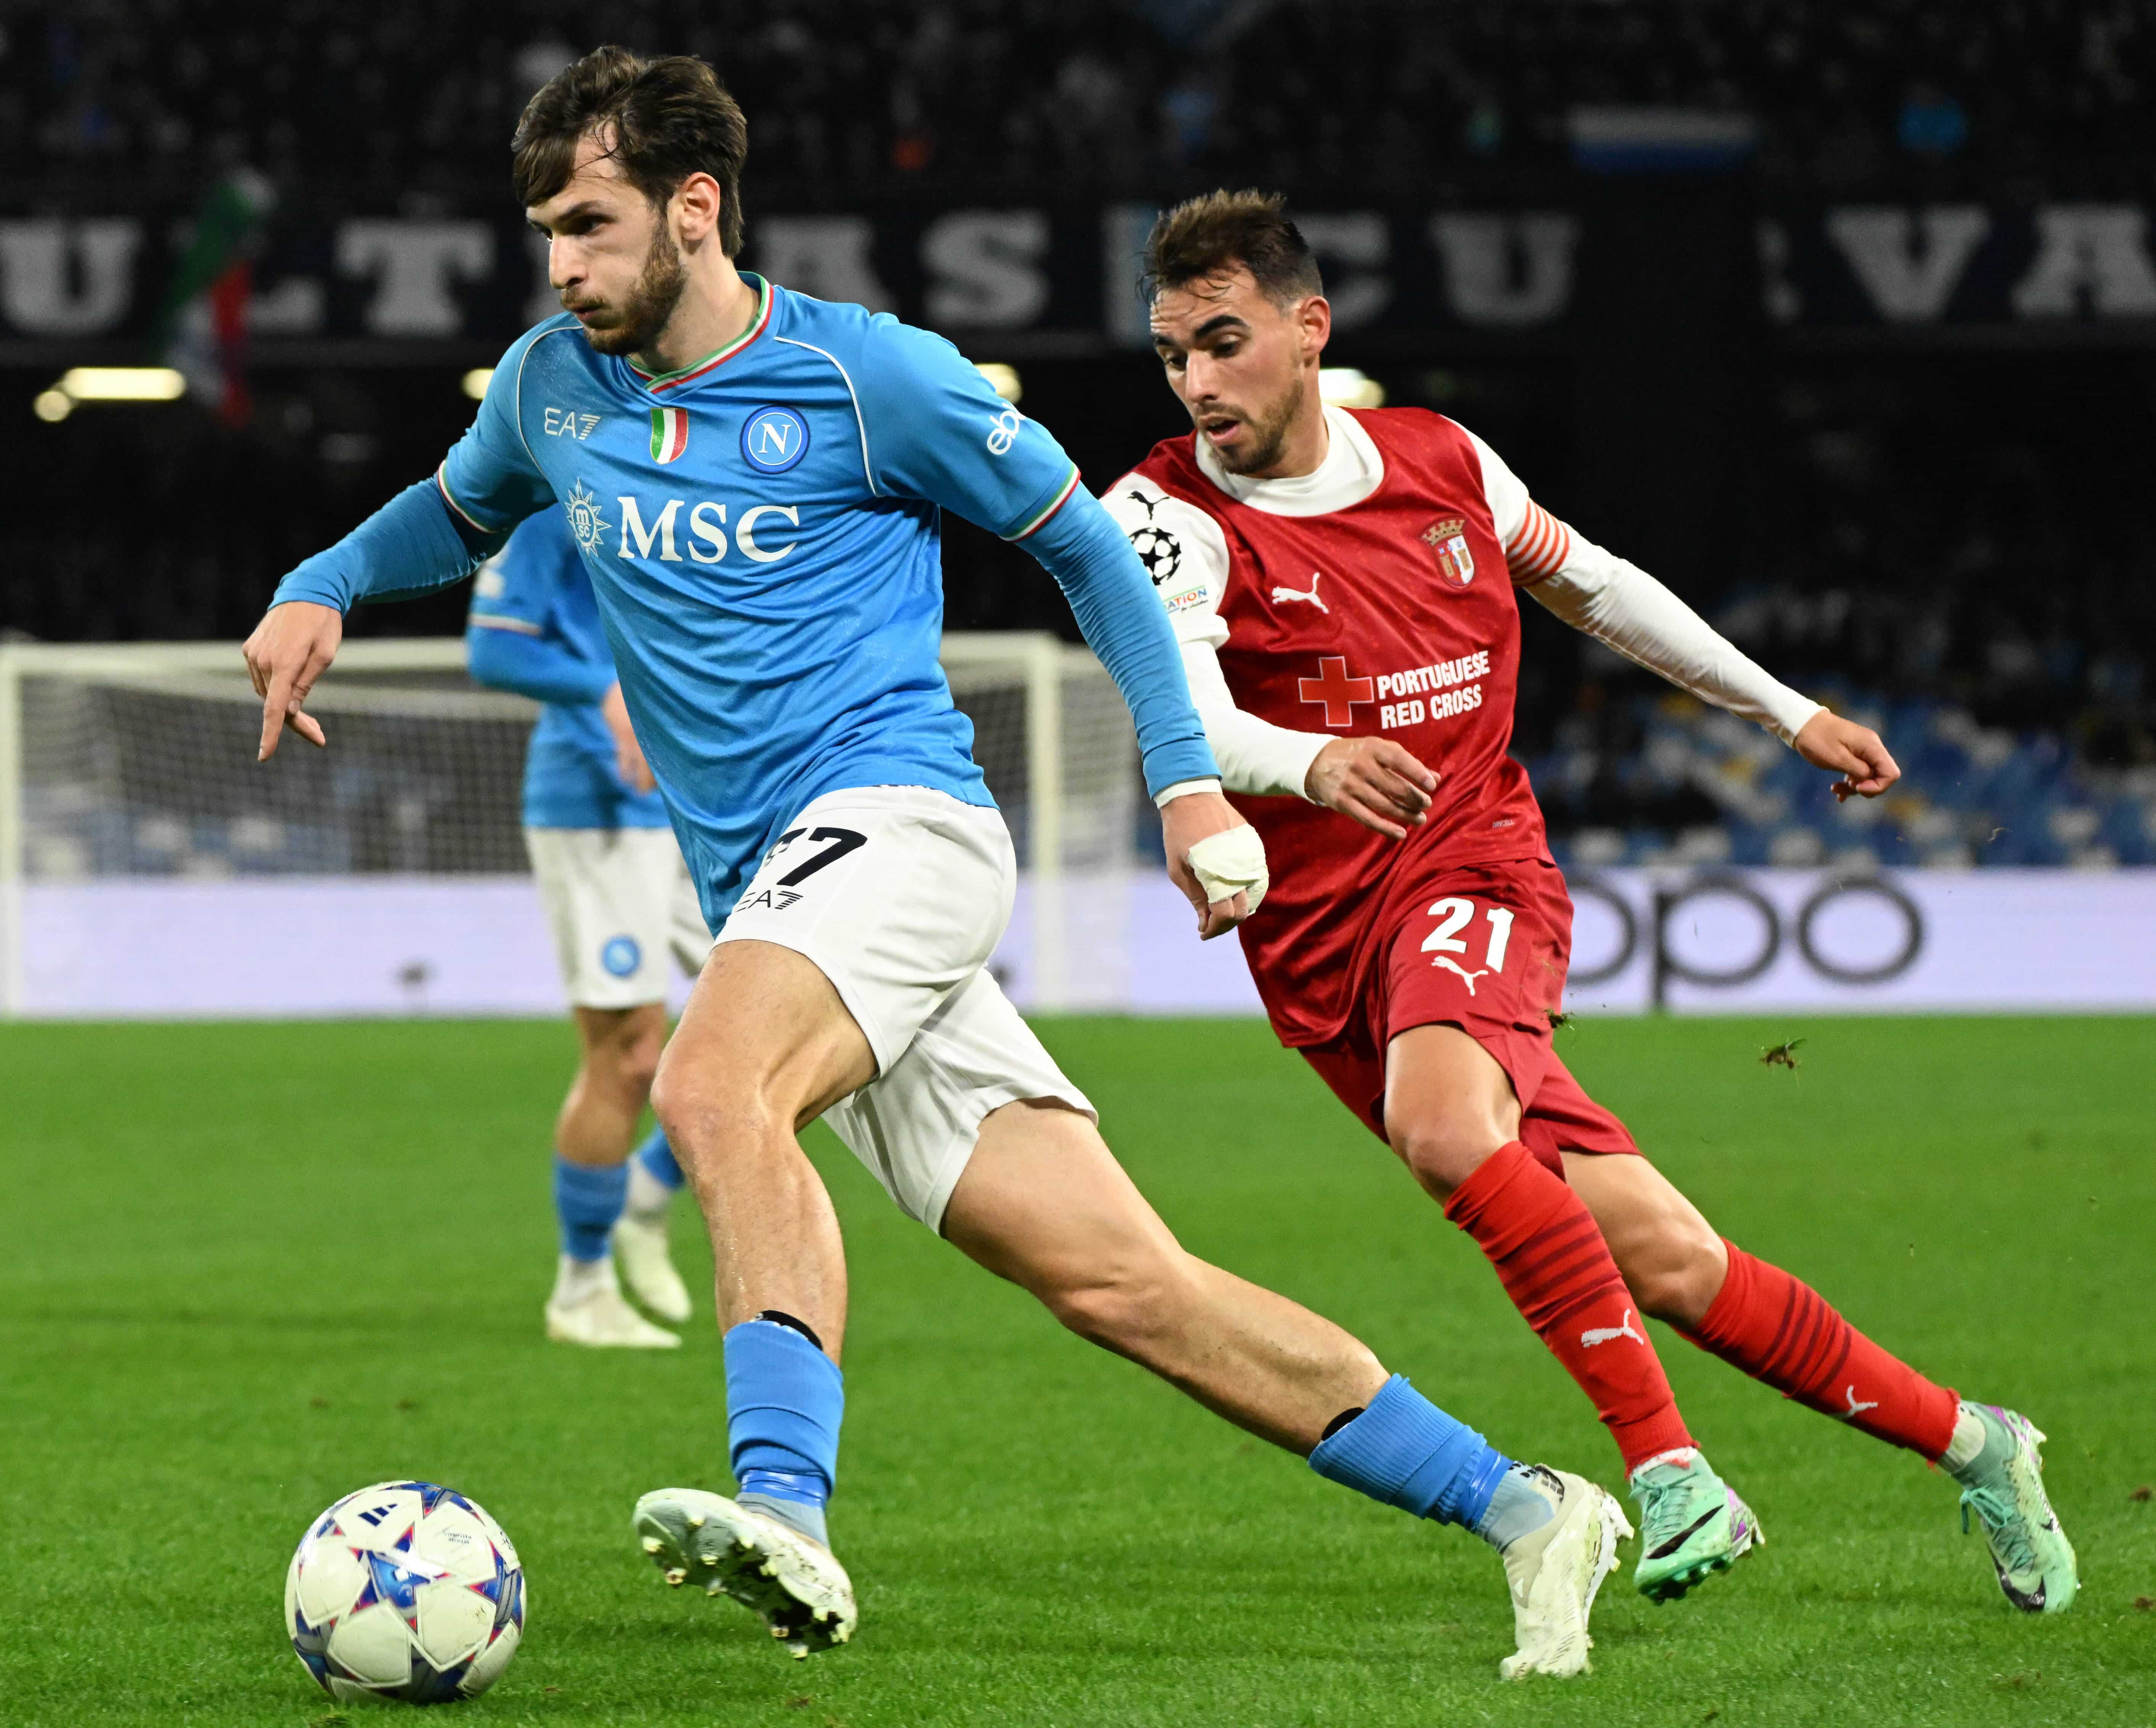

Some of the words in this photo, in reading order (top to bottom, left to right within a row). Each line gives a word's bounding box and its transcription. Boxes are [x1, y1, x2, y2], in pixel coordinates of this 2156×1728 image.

[758, 423, 791, 455] N
[987, 402, 1027, 455] eb
[617, 496, 800, 564] MSC
[1164, 588, 1207, 610] ATION
[1376, 650, 1490, 699] PORTUGUESE
[1380, 699, 1425, 730] RED
[1430, 684, 1482, 720] CROSS
[1420, 897, 1514, 973] 21
